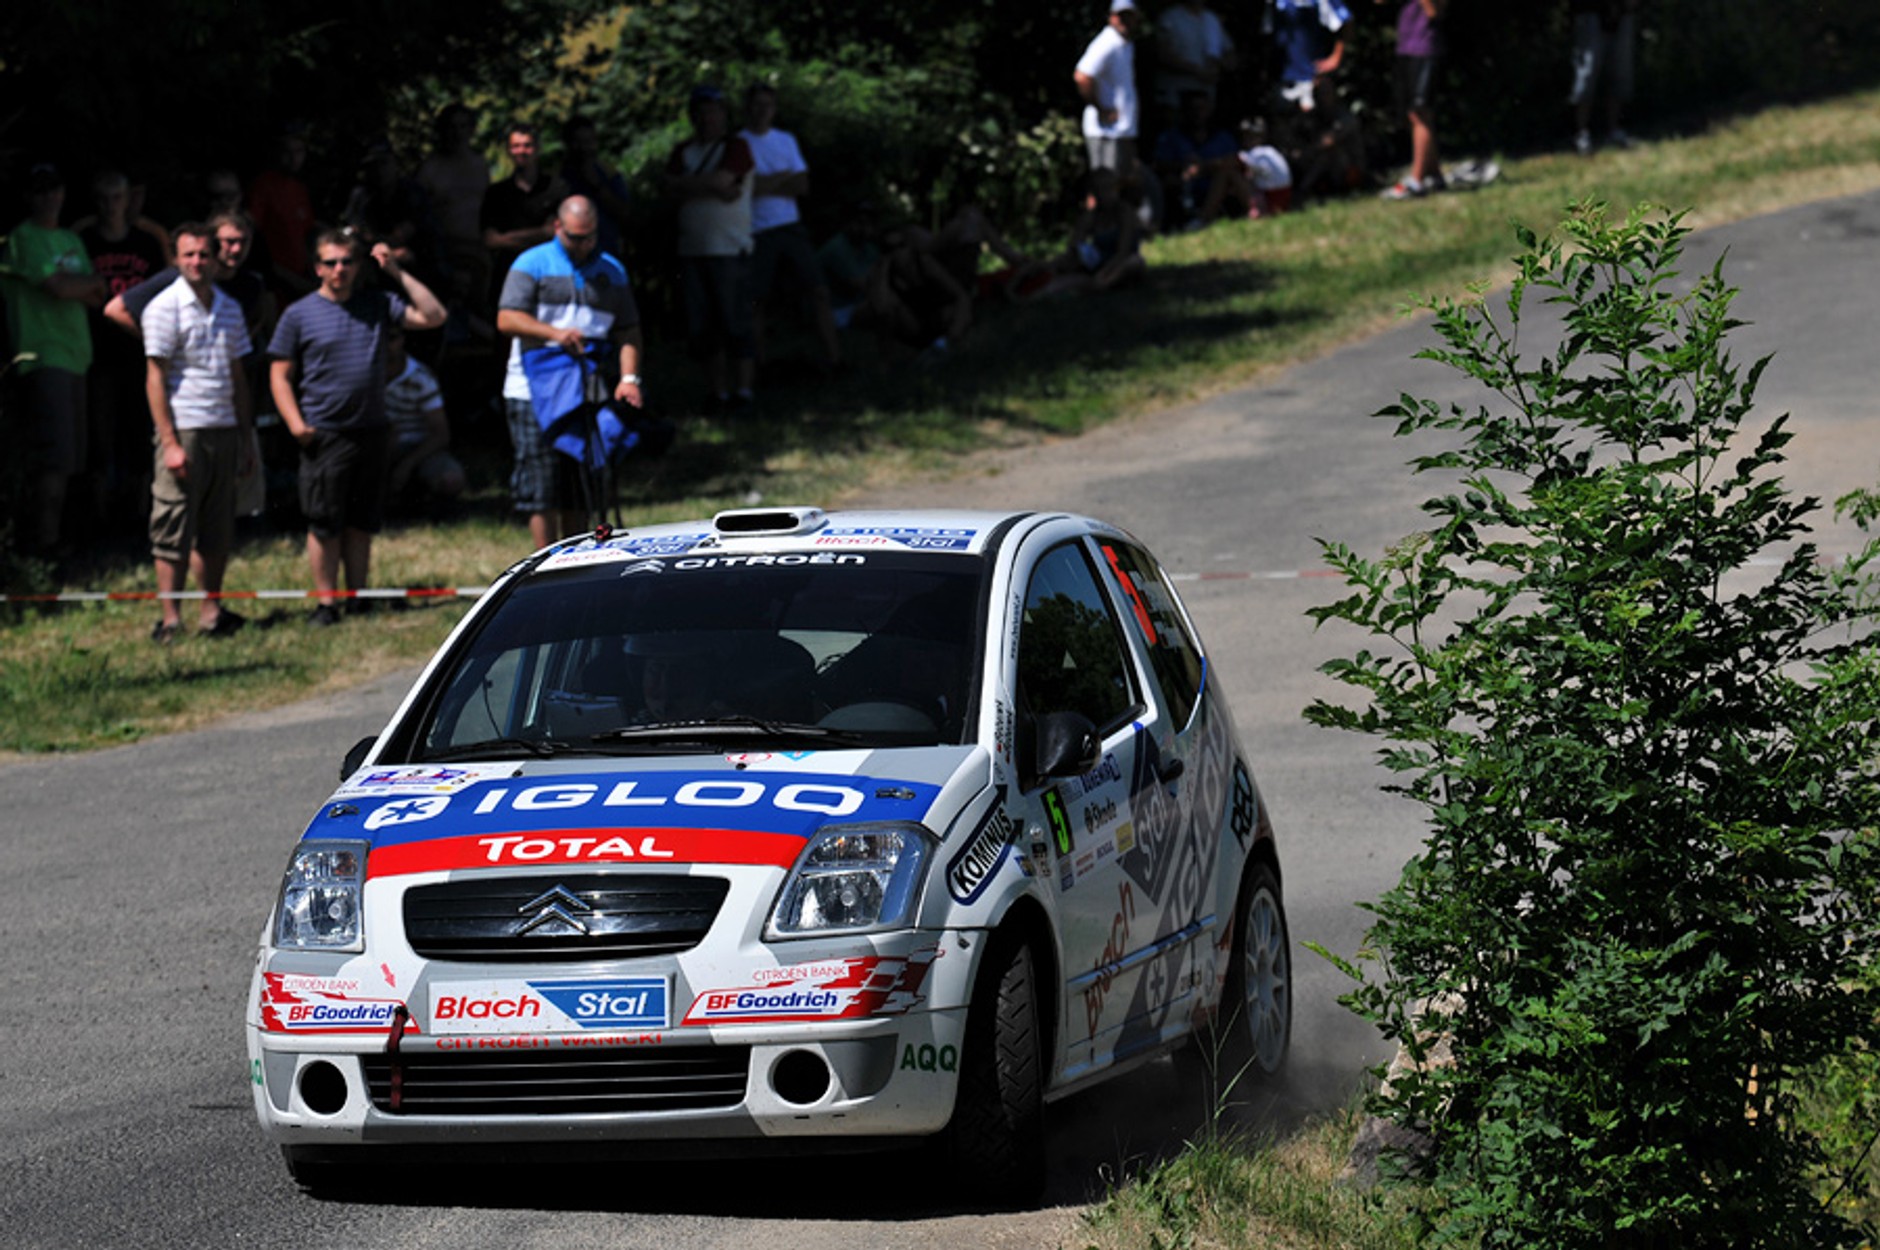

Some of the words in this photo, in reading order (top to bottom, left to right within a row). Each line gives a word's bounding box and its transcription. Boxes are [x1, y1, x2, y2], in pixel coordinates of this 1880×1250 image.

[1046, 791, 1069, 855] 5
[478, 836, 674, 862] TOTAL
[953, 807, 1014, 895] KOMINUS
[811, 965, 847, 978] BANK
[328, 980, 360, 991] BANK
[434, 994, 541, 1020] Blach
[576, 991, 649, 1017] Stal
[706, 992, 838, 1010] BFGoodrich
[561, 1033, 662, 1047] WANICKI
[900, 1043, 958, 1072] AQQ
